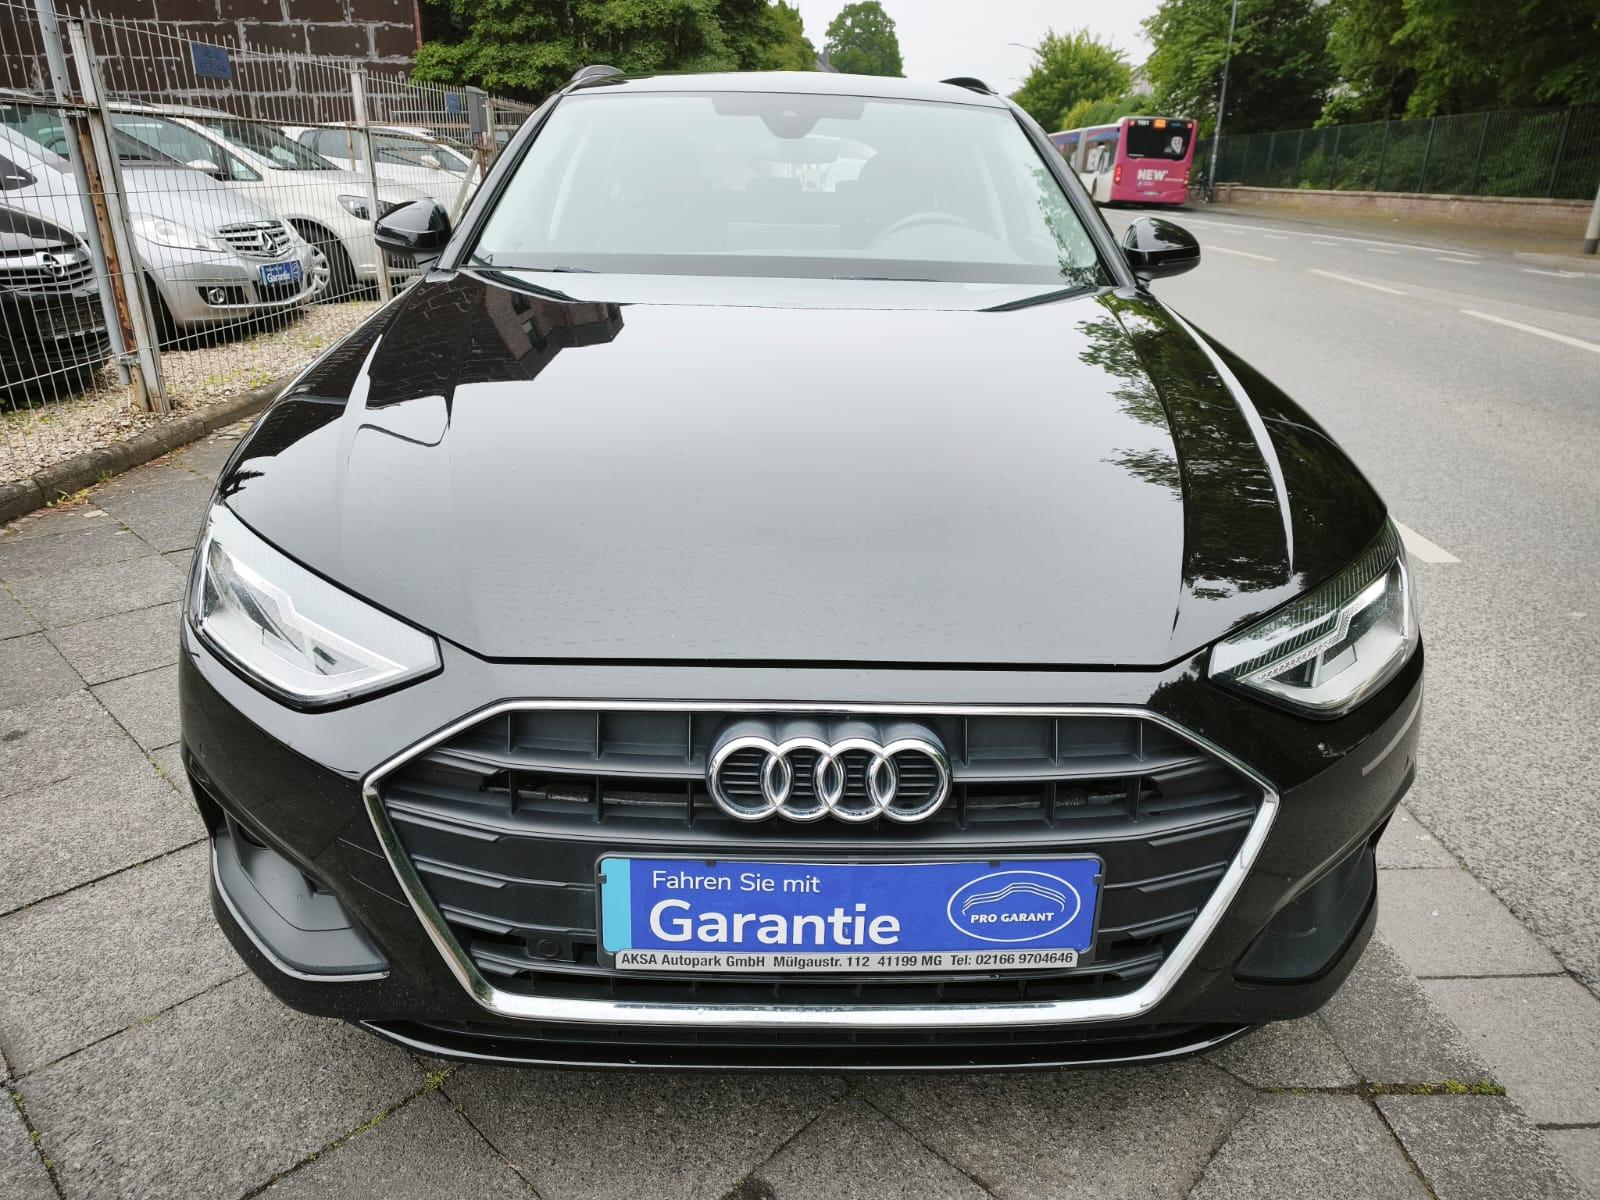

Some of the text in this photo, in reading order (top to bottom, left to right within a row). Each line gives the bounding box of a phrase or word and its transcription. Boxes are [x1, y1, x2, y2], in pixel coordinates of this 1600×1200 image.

[1137, 169, 1167, 181] NEW
[652, 870, 821, 893] Fahren Sie mit
[650, 898, 901, 945] Garantie
[970, 912, 1055, 923] PRO GARANT
[621, 952, 1073, 969] AKSA Autopark GmbH Mülgaustr. 112 41199 MG Tel: 02166 9704646
